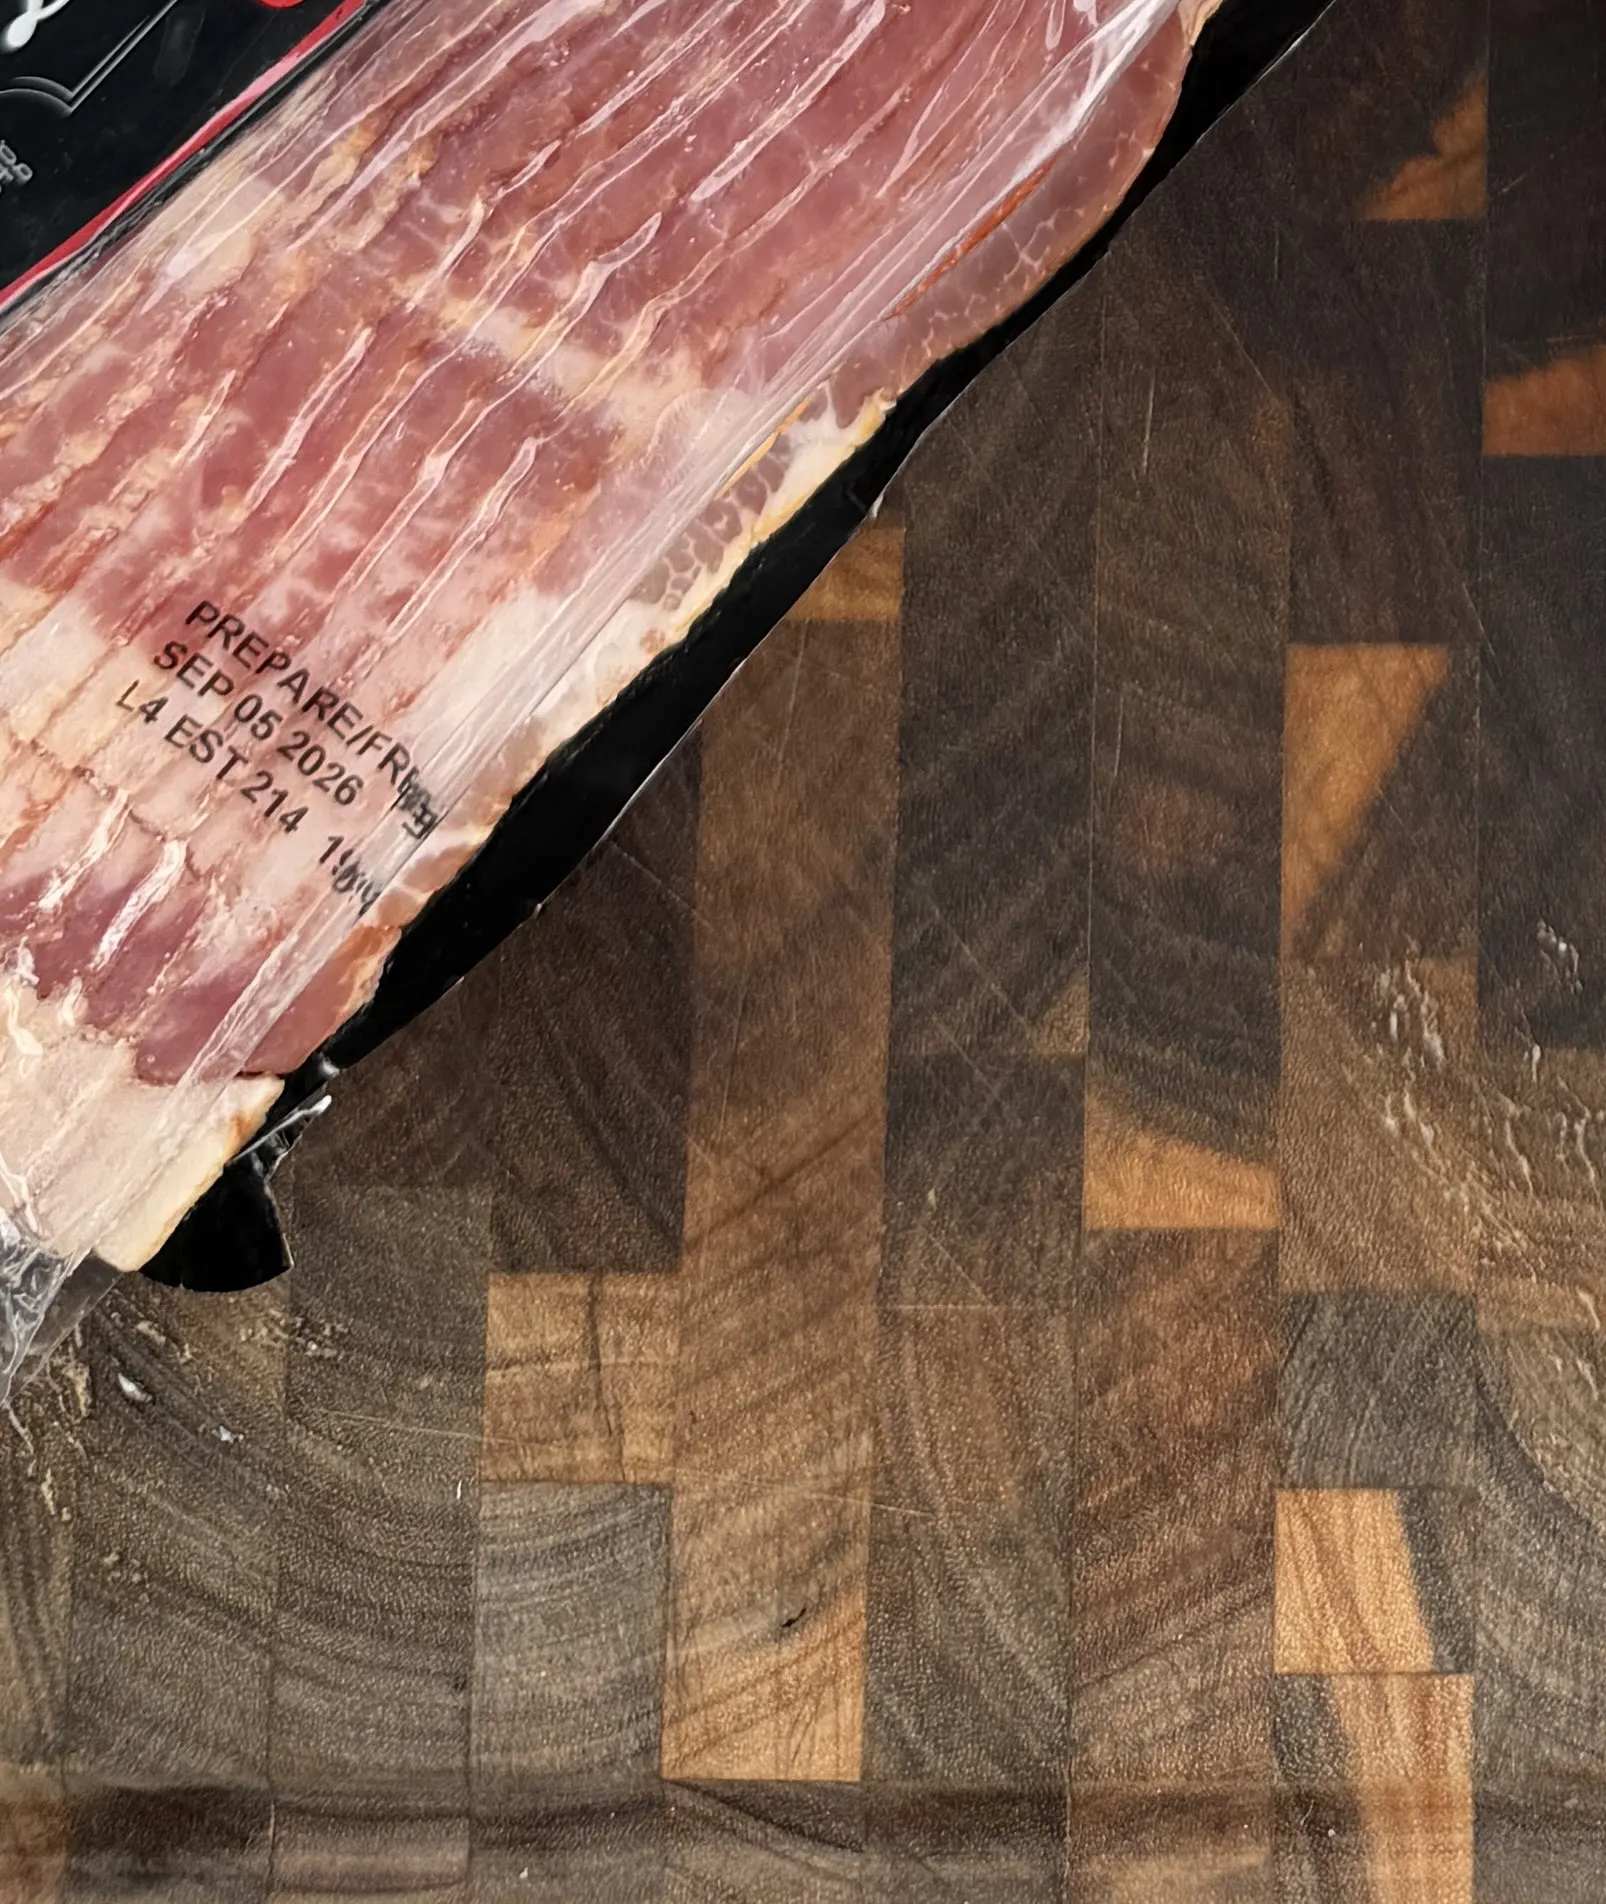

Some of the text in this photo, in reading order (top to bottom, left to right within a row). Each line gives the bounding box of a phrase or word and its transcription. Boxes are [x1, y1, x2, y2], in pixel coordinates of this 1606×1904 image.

[115, 680, 309, 833] L4 EST 214
[153, 641, 364, 806] SEP 05 2026
